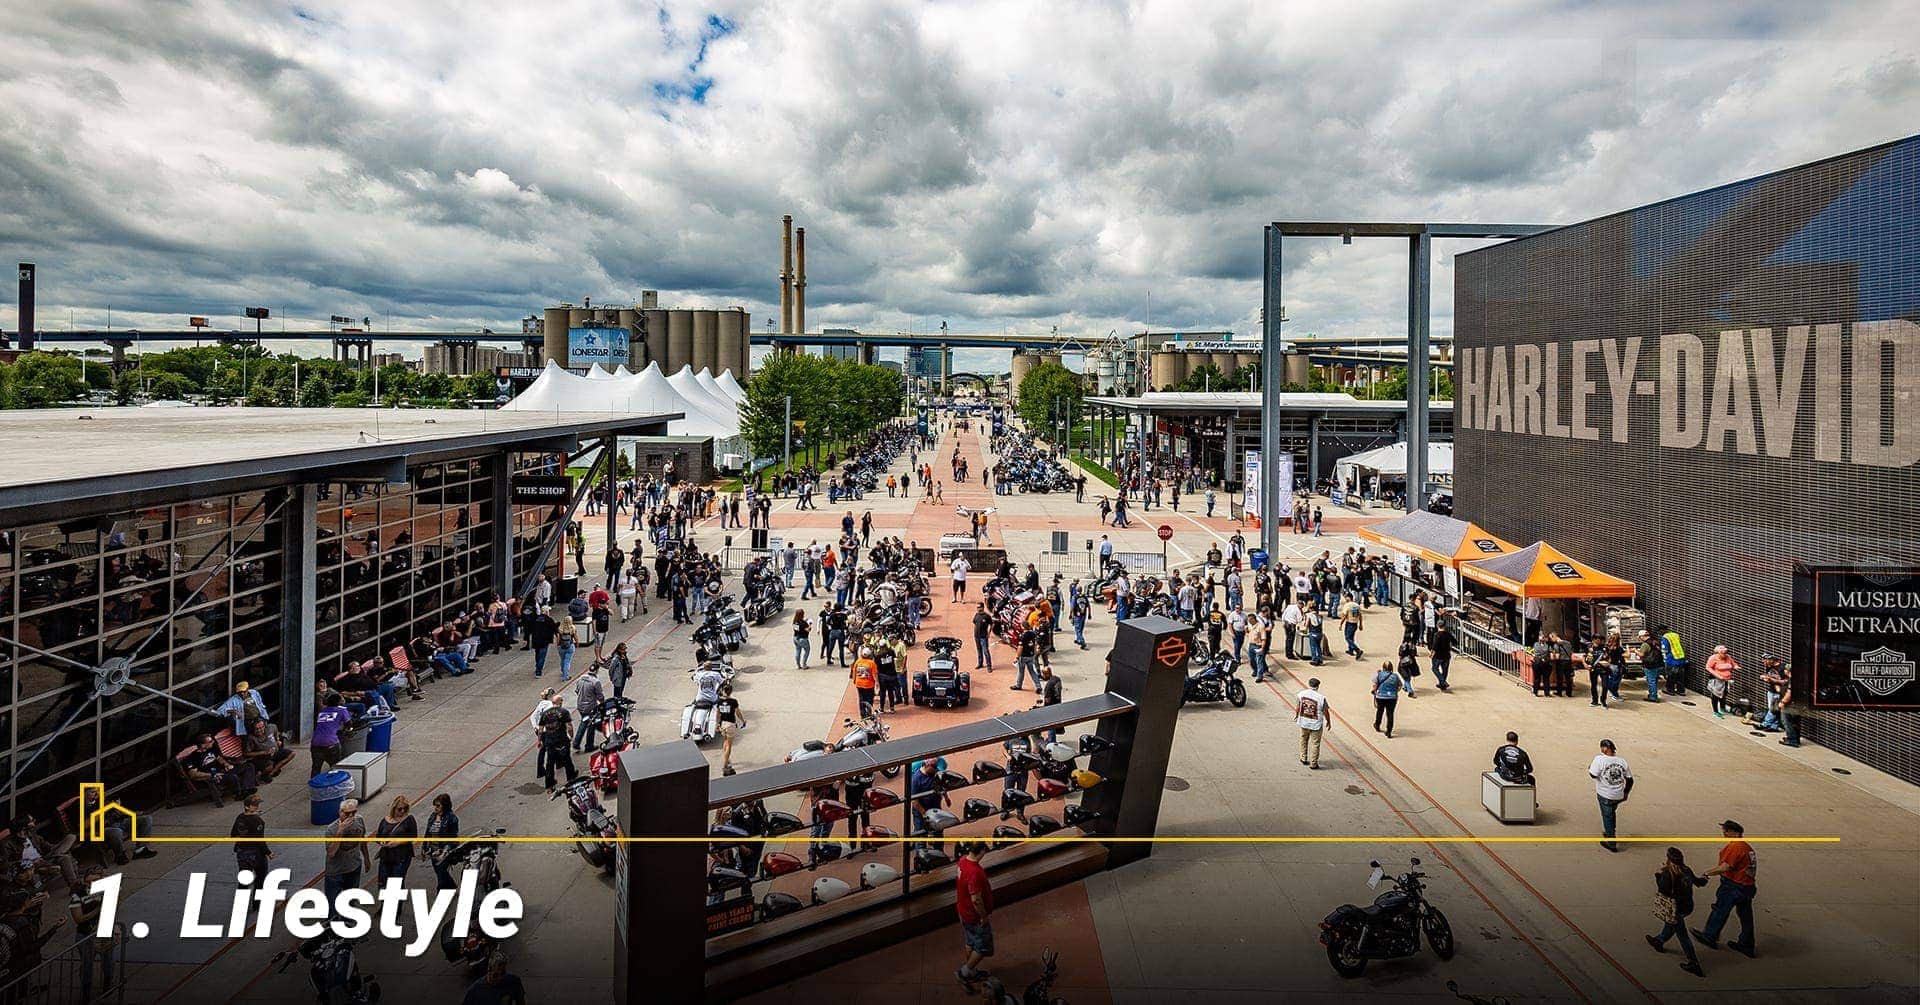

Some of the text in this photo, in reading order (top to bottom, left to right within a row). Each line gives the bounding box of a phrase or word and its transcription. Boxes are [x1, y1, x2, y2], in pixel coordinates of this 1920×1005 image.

[572, 347, 609, 357] LONESTAR
[516, 486, 566, 495] THE SHOP
[1159, 529, 1172, 537] STOP
[1869, 653, 1898, 663] MOTOR
[1856, 665, 1910, 675] HARLEY-DAVIDSON
[1868, 678, 1898, 690] CYCLES
